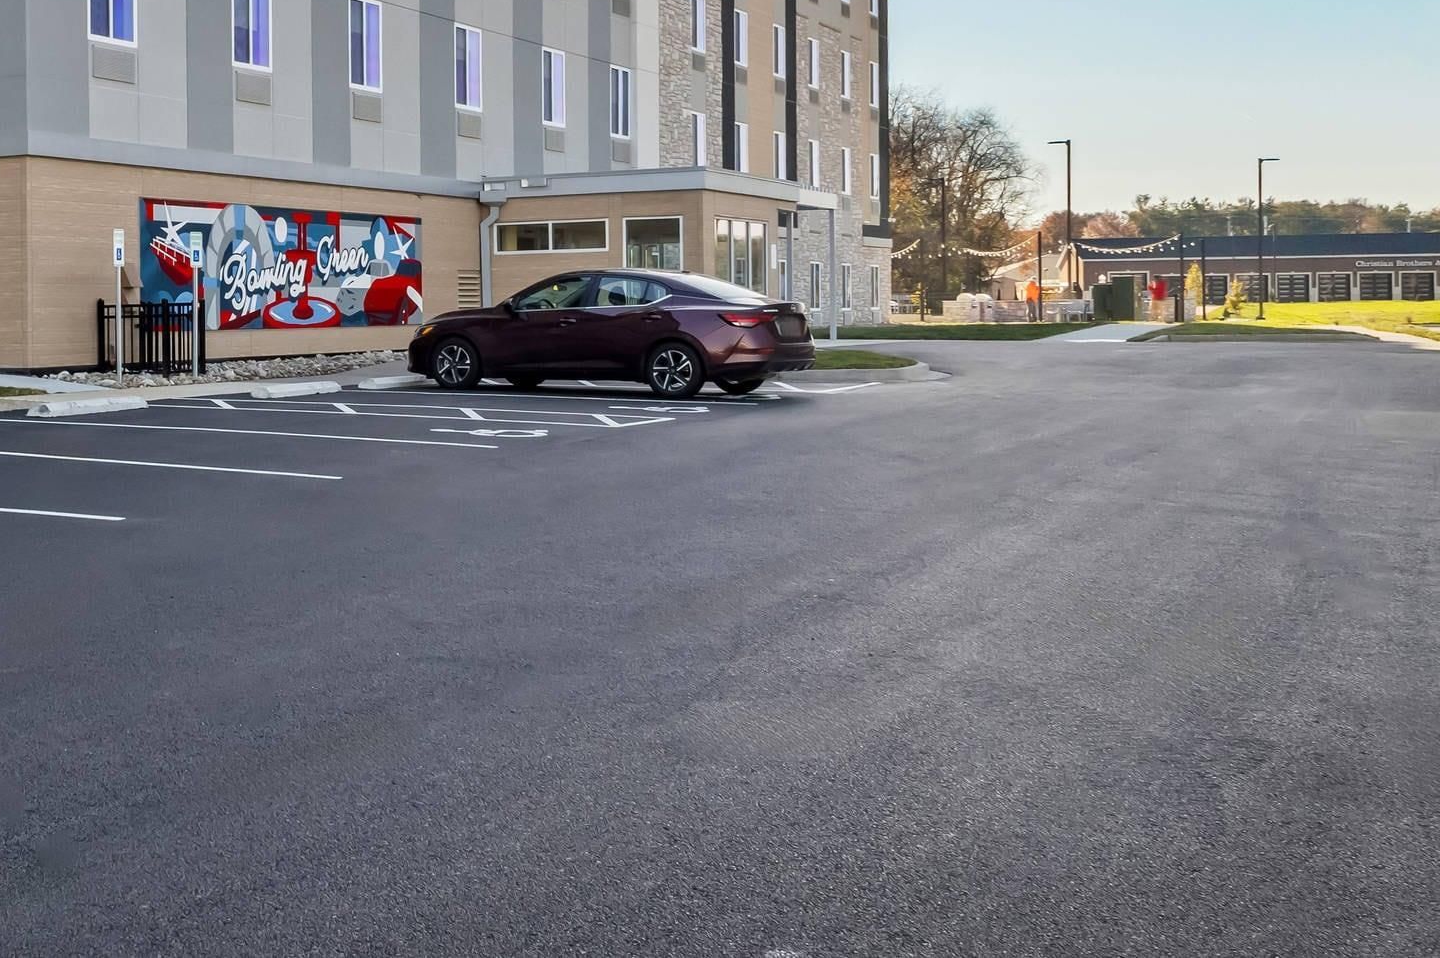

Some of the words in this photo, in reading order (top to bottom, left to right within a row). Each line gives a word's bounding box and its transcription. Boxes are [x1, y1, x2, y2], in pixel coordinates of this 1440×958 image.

[222, 252, 307, 310] Bowling
[317, 235, 368, 281] Green
[1396, 259, 1433, 267] Brothers
